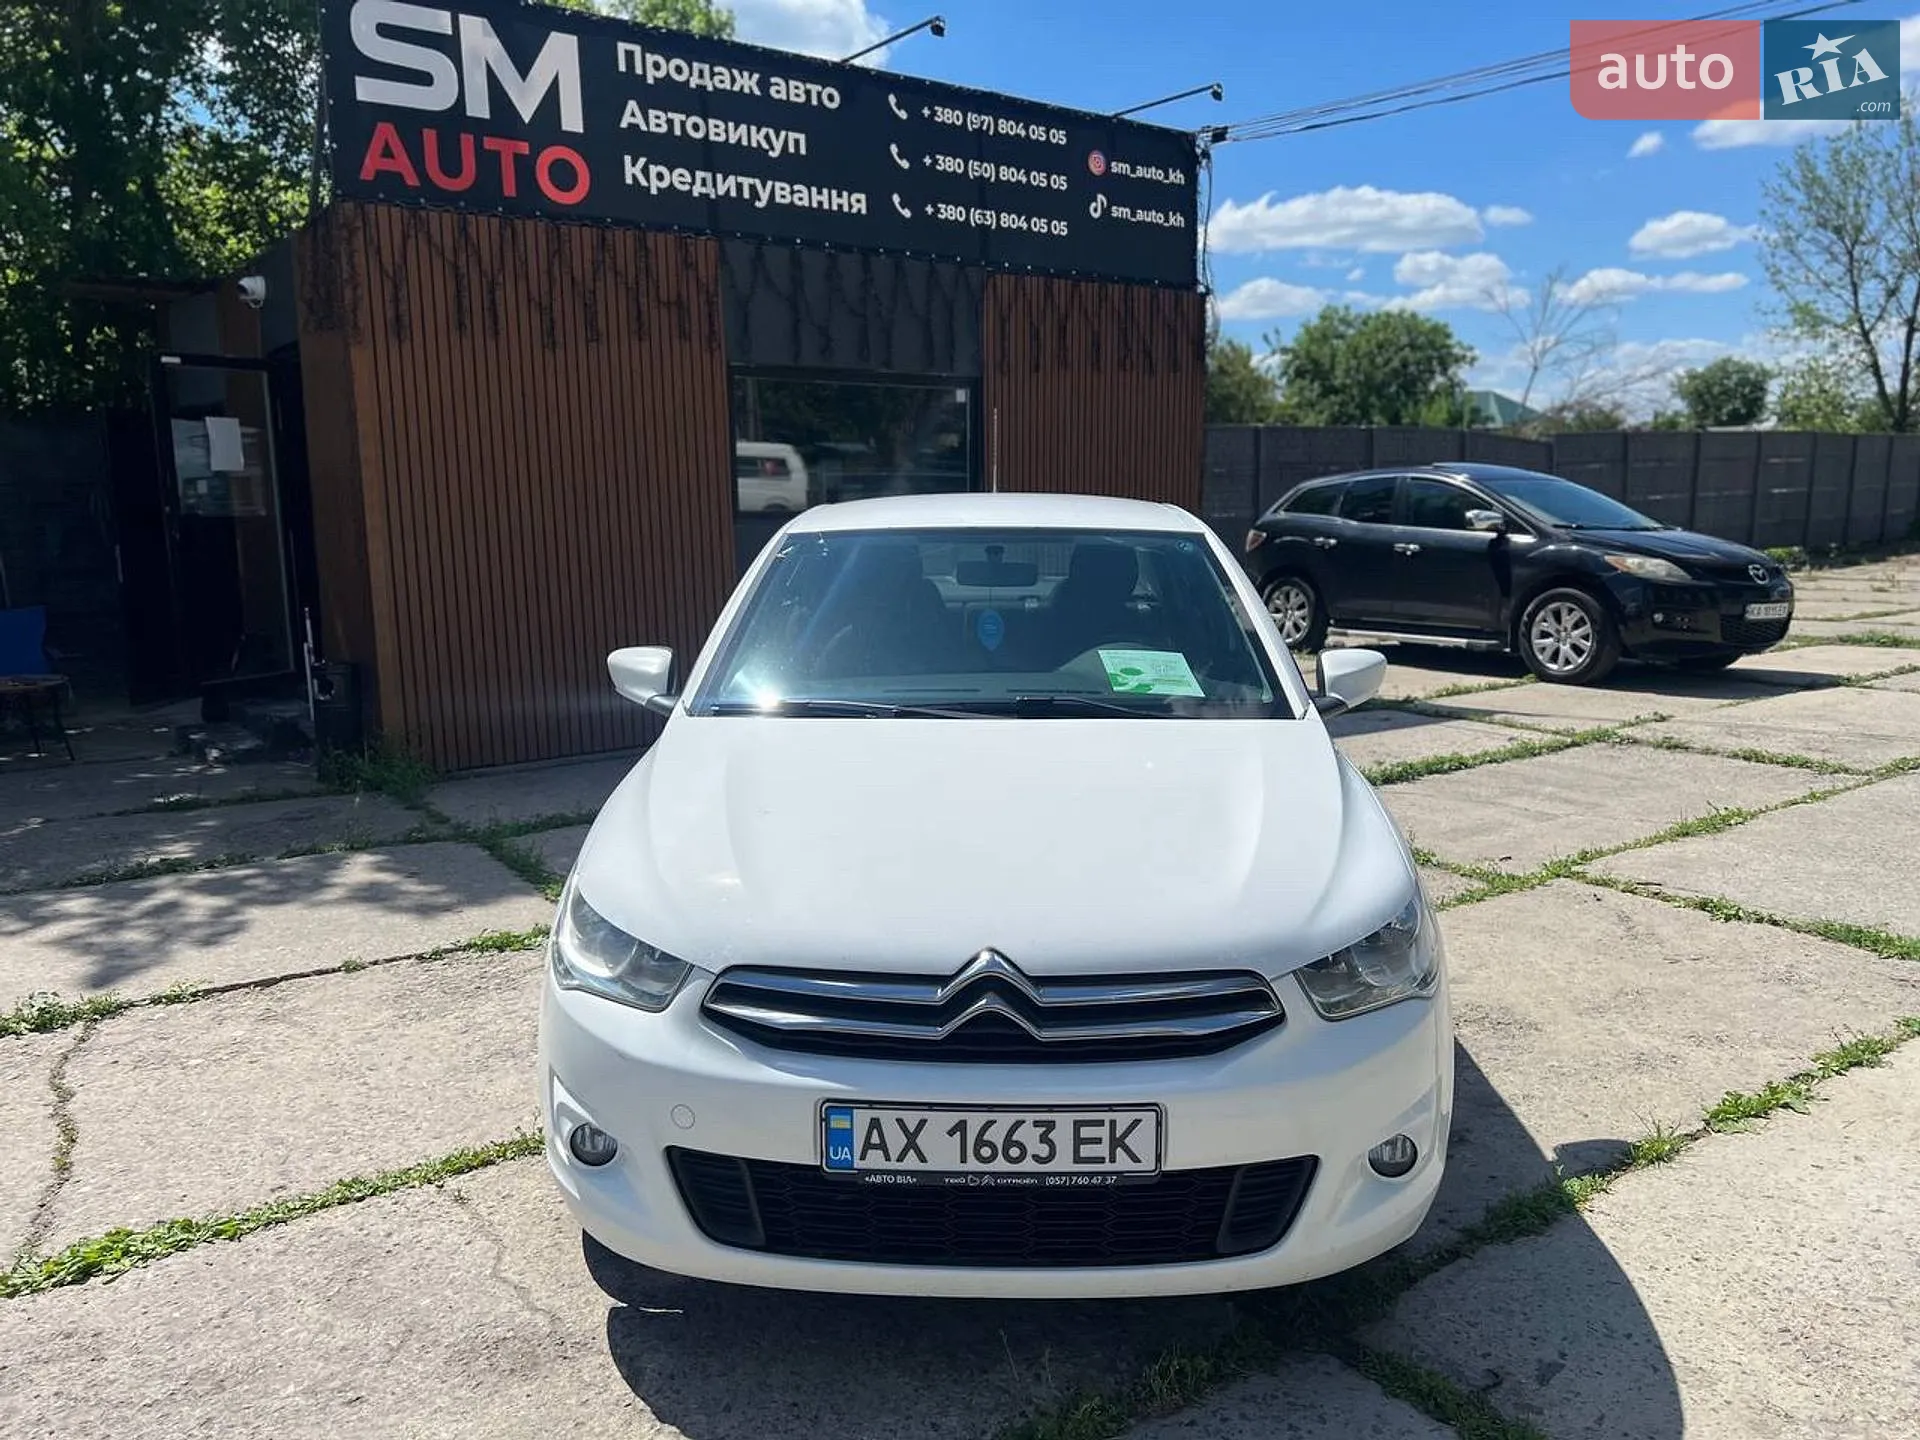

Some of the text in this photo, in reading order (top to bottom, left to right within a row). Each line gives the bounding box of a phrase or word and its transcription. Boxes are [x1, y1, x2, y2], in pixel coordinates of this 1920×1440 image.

[351, 0, 584, 133] SM
[616, 41, 842, 110] Продаж авто
[619, 100, 807, 157] Автовикуп
[934, 106, 964, 126] 380
[966, 112, 995, 136] (97)
[997, 118, 1027, 138] 804
[1028, 124, 1047, 142] 05
[1049, 128, 1067, 145] 05
[360, 121, 591, 205] AUTO
[935, 154, 965, 174] 380
[967, 160, 996, 182] (50)
[999, 166, 1028, 185] 804
[1029, 170, 1048, 188] 05
[1050, 174, 1068, 191] 05
[1110, 161, 1185, 185] sm_auto_kh
[623, 155, 867, 215] Кредитування
[937, 203, 967, 222] 380
[969, 208, 997, 229] (63)
[999, 212, 1029, 231] 804
[1030, 216, 1049, 234] 05
[1051, 219, 1068, 236] 05
[1110, 205, 1185, 228] sm_auto_kh
[830, 1147, 852, 1160] UA
[859, 1117, 1143, 1165] AX 1663 EK
